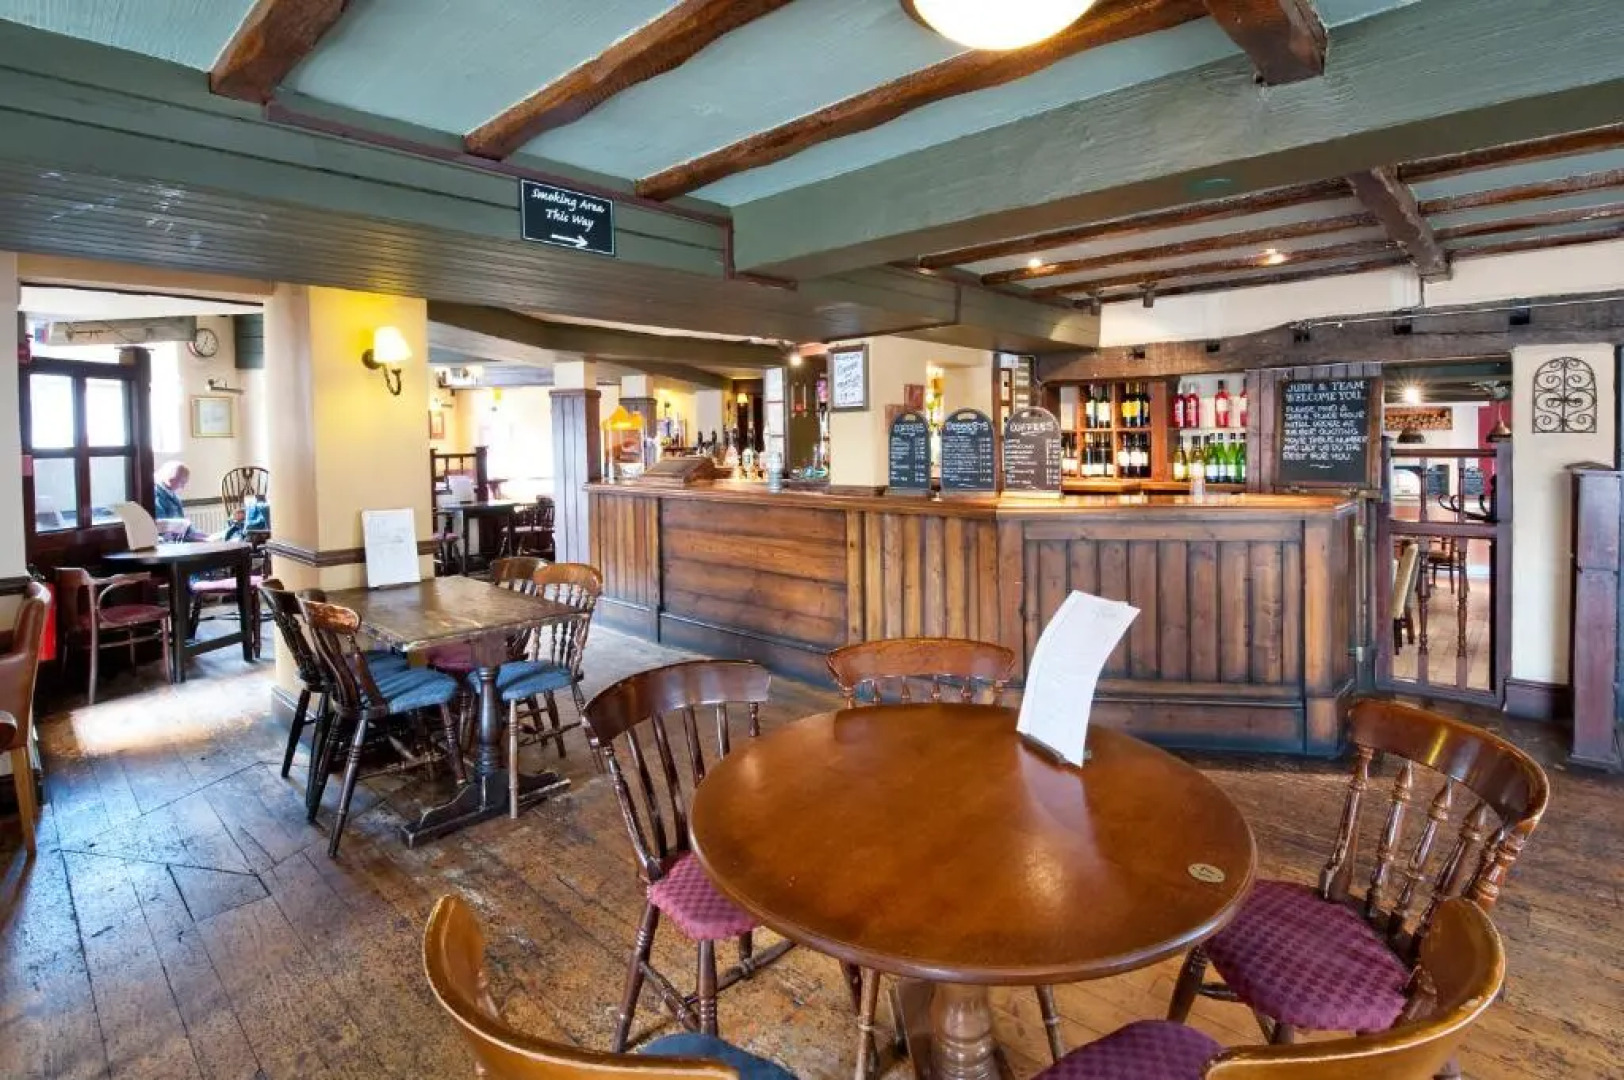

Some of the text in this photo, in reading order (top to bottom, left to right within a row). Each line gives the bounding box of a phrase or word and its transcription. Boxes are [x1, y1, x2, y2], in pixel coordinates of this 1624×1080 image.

[531, 189, 605, 213] Smoking Area
[545, 208, 594, 232] This Way
[1332, 381, 1364, 391] TEAM
[1285, 392, 1336, 402] WELCOME
